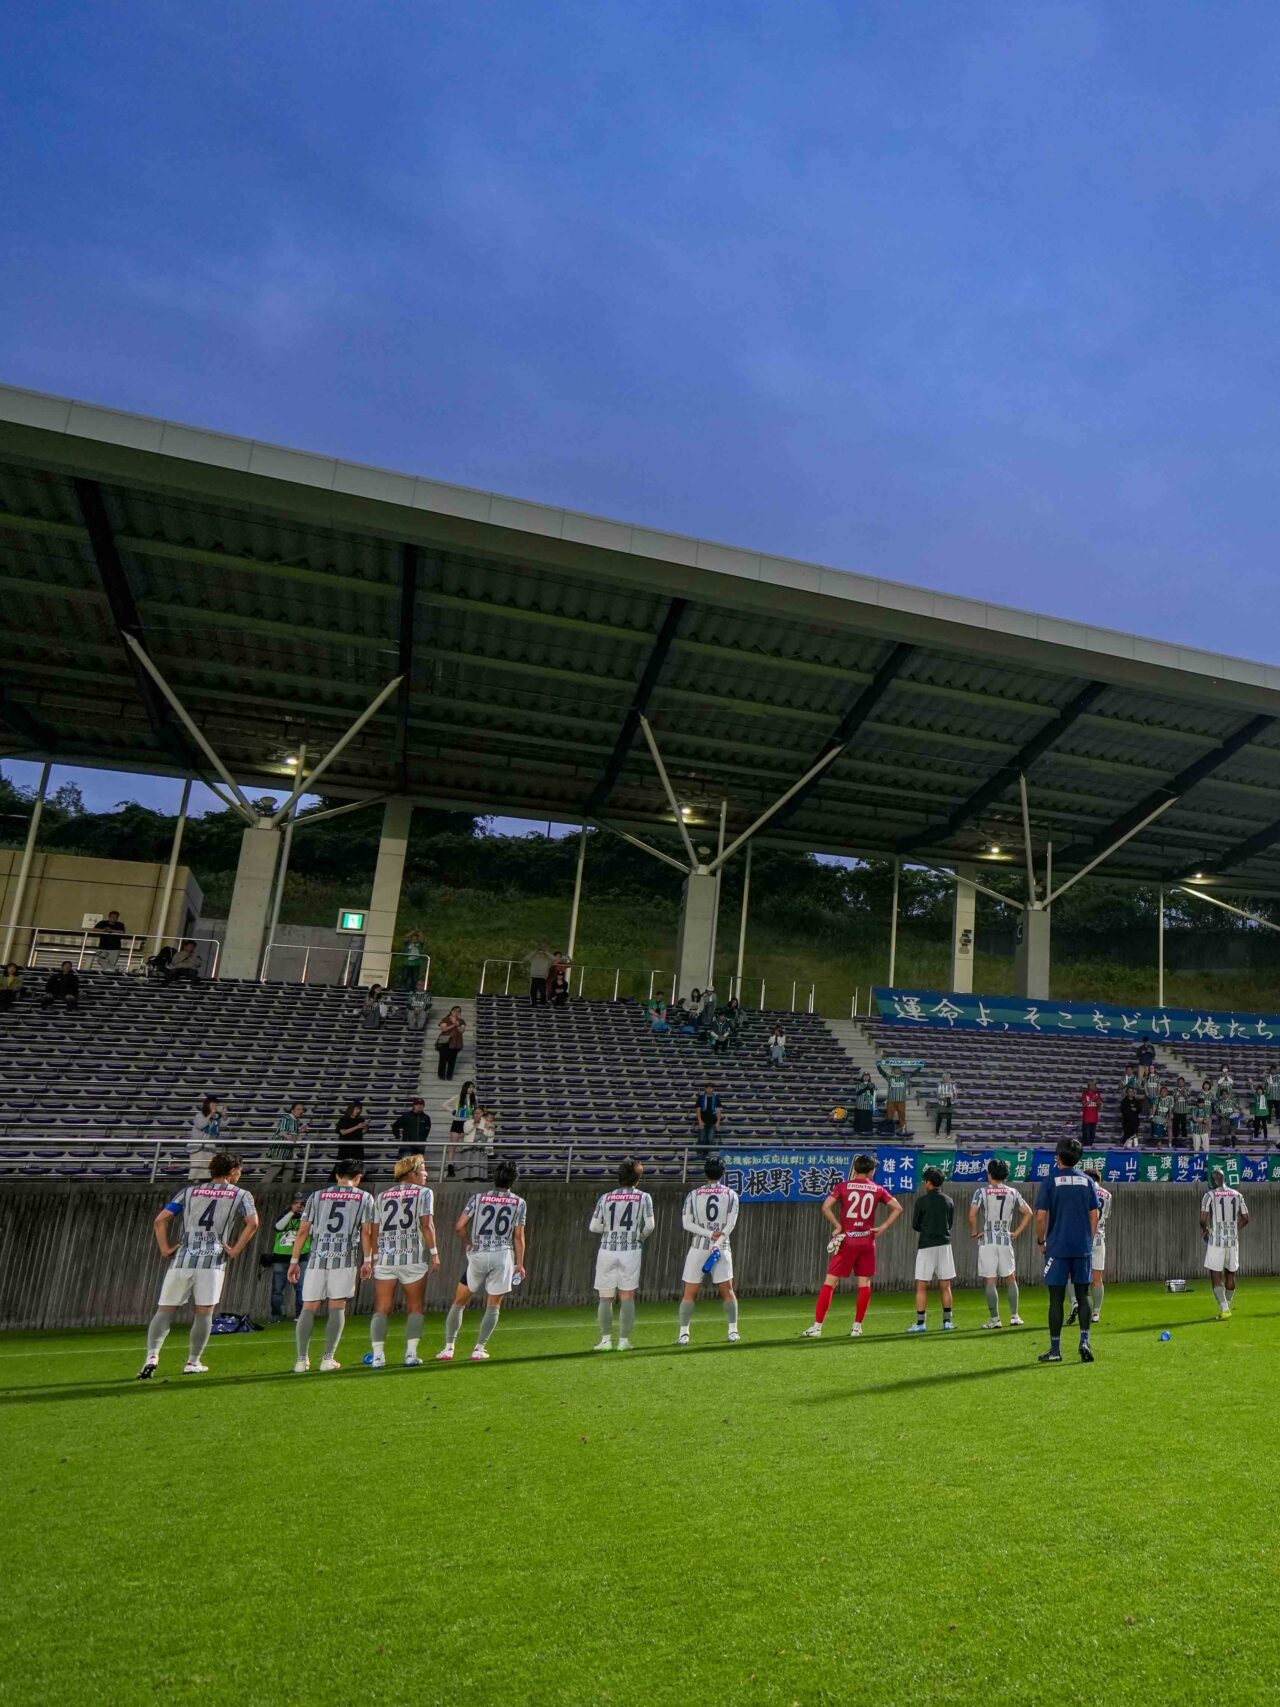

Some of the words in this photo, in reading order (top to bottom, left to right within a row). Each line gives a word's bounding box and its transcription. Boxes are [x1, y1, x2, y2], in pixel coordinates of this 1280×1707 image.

[193, 1188, 235, 1197] FRONTIER
[321, 1192, 361, 1200] FRONTIER
[383, 1190, 418, 1199] FRONTIER
[607, 1193, 640, 1201] FRONTIER
[848, 1183, 877, 1191] FRONTIER
[481, 1196, 517, 1205] FRONTIER
[705, 1194, 719, 1222] 6
[846, 1191, 875, 1220] 20
[996, 1195, 1006, 1221] 7
[1220, 1197, 1236, 1222] 11
[198, 1199, 218, 1232] 4
[326, 1201, 346, 1234] 5
[383, 1197, 414, 1232] 23
[479, 1204, 512, 1237] 26
[608, 1201, 633, 1232] 14
